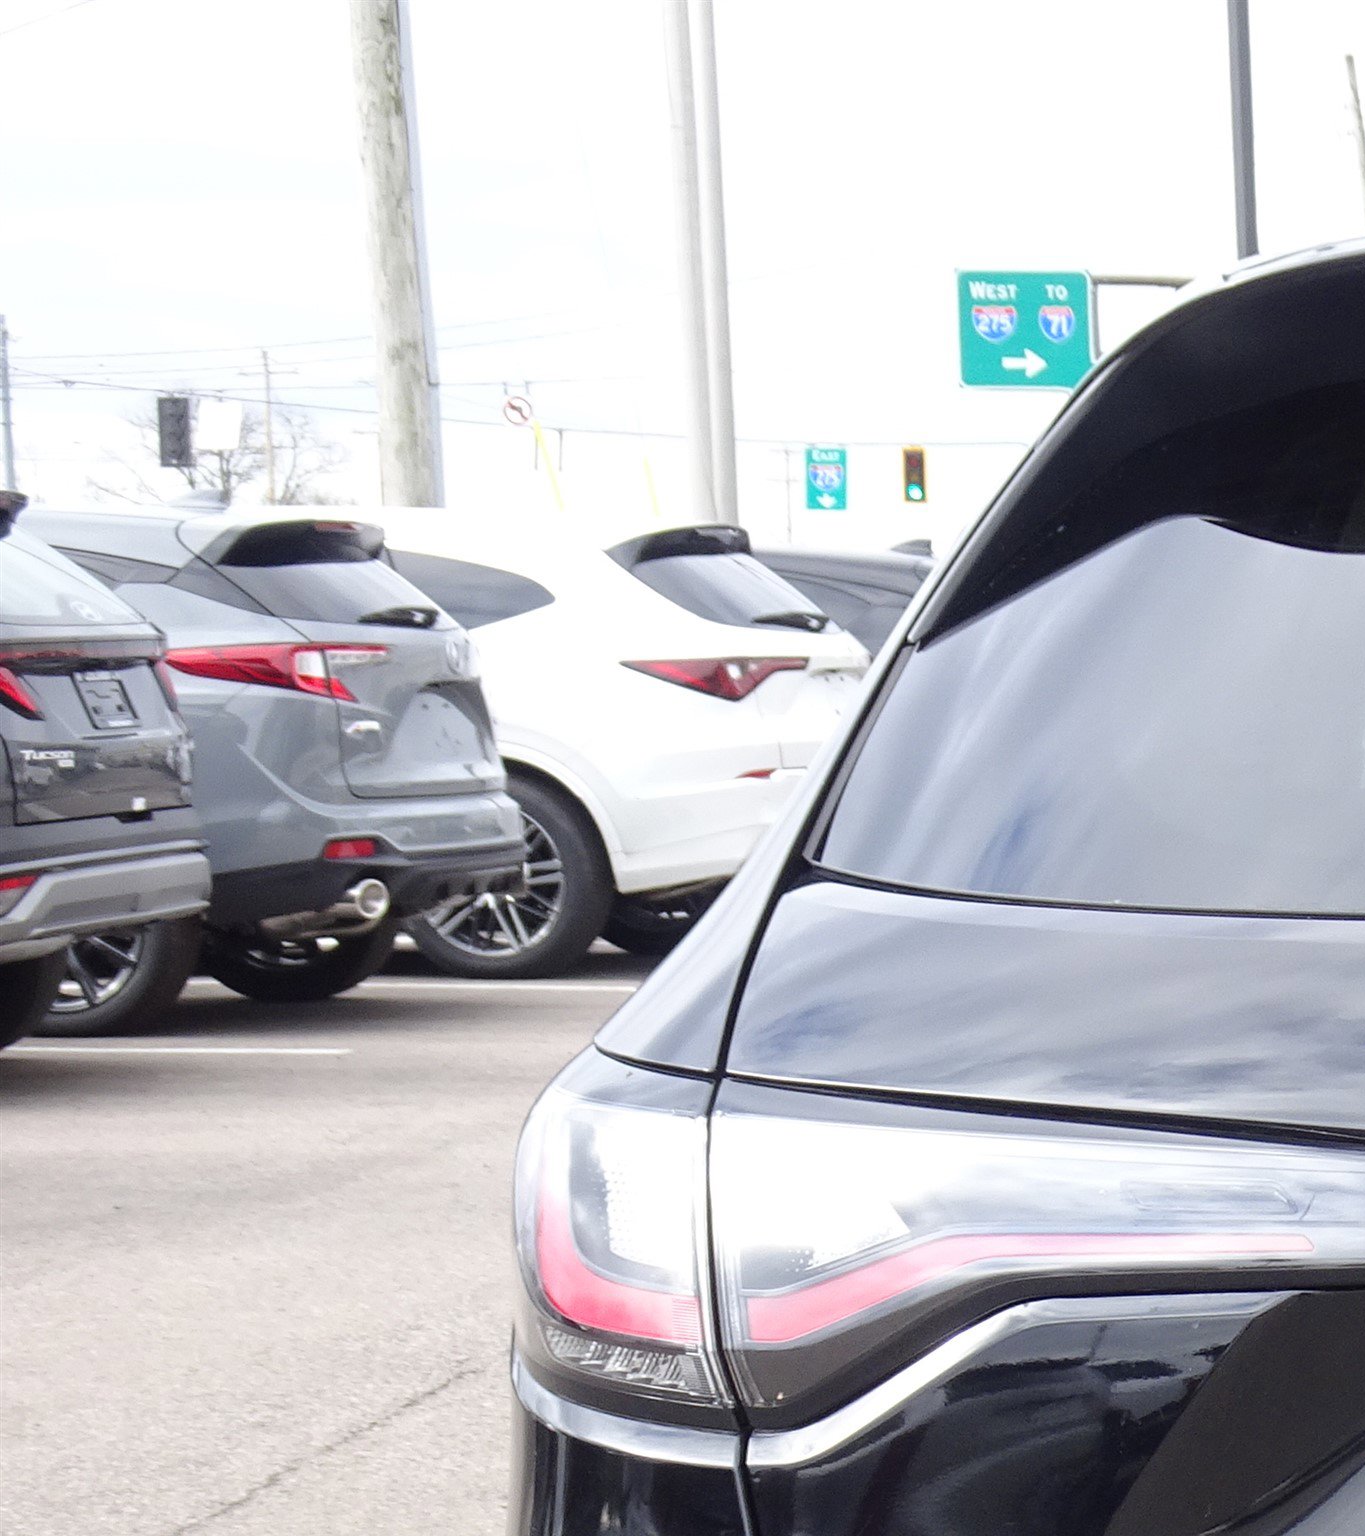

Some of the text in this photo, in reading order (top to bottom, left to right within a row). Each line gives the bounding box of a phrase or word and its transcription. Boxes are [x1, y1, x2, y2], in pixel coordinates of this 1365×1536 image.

[968, 281, 1069, 301] WEST TO
[977, 315, 1068, 336] 275 71
